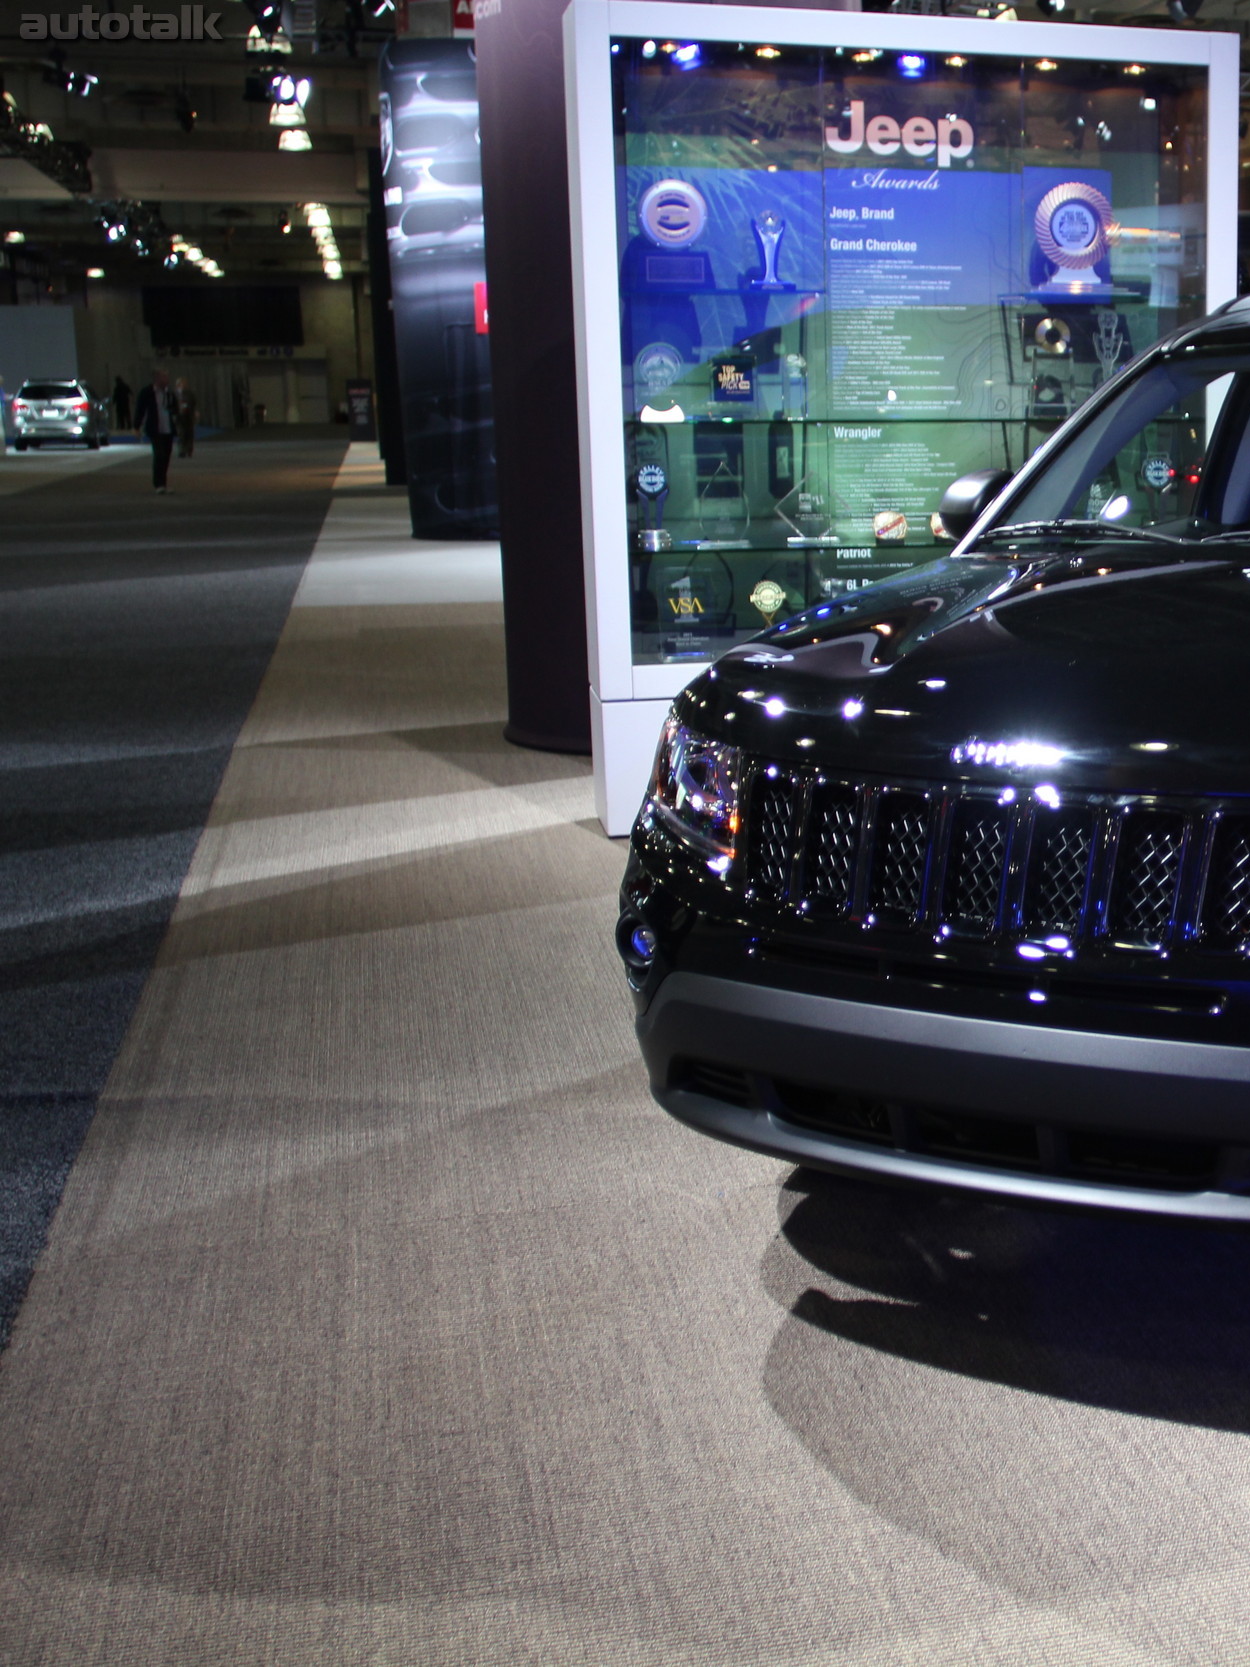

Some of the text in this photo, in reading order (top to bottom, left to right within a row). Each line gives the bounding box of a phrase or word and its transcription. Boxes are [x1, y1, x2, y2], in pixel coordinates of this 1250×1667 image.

[825, 100, 974, 167] Jeep
[851, 168, 940, 190] Awards
[861, 207, 895, 220] Brand
[830, 238, 917, 252] Grand Cherokee
[834, 426, 882, 440] Wrangler
[836, 548, 872, 559] Patriot
